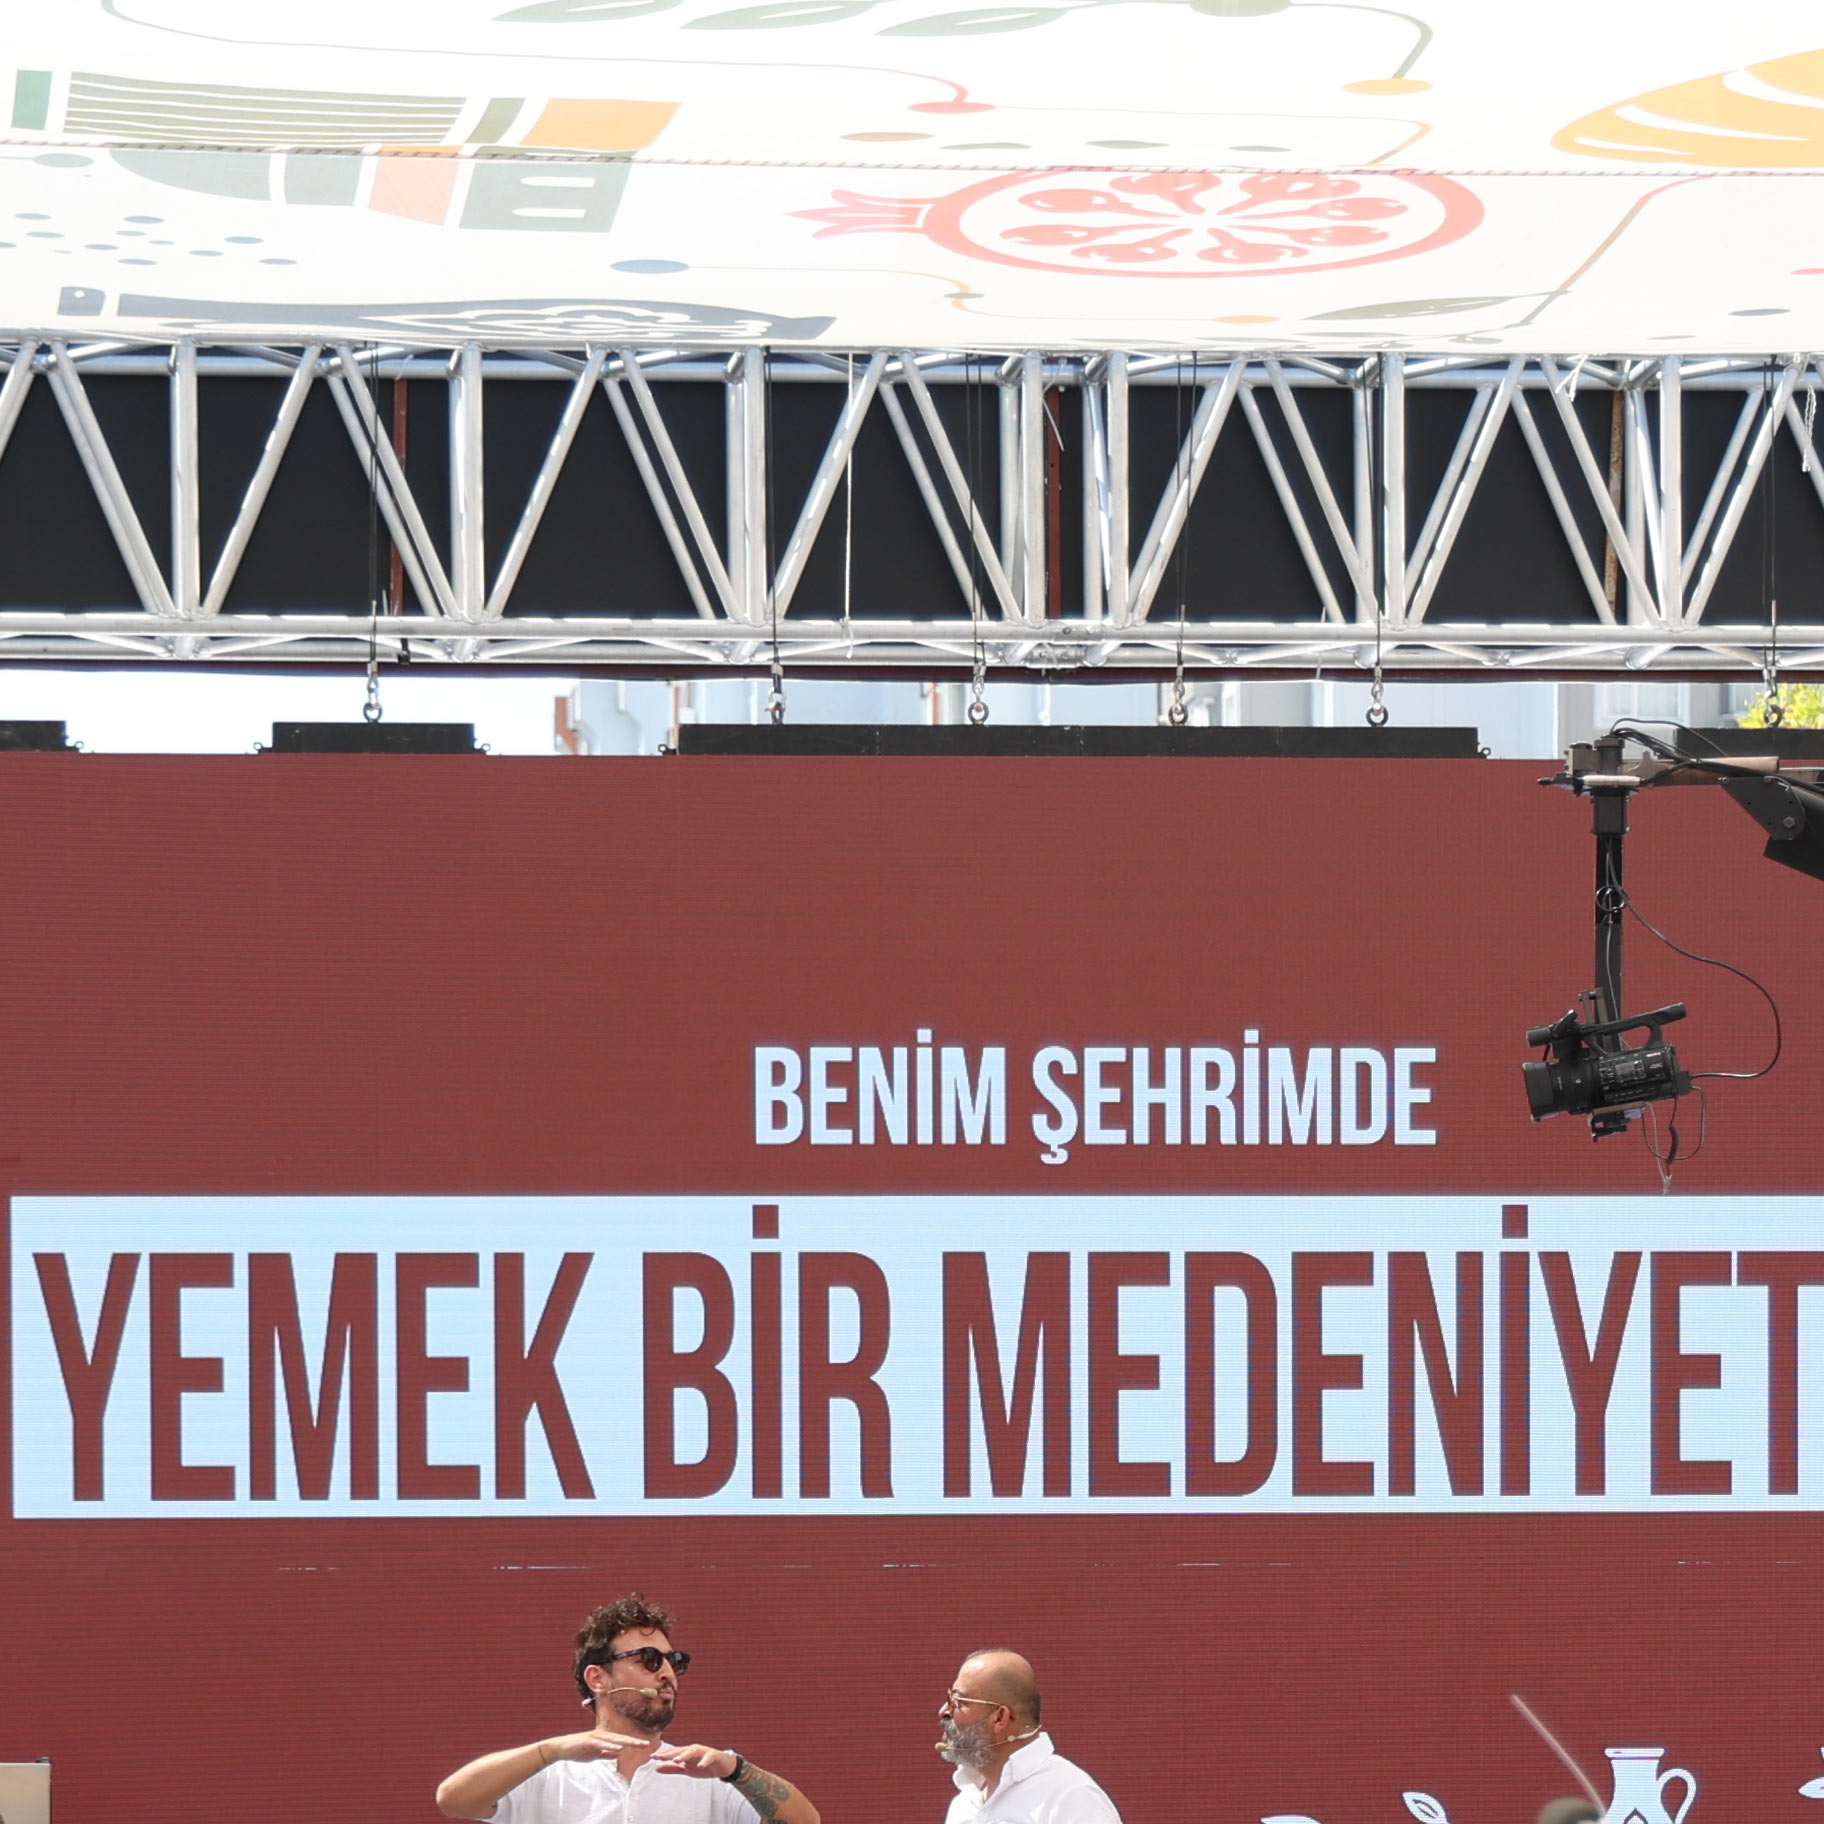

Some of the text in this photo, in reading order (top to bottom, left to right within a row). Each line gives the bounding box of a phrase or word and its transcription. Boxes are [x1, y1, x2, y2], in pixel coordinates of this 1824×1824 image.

[754, 1028, 1437, 1165] BENİM ŞEHRİMDE
[33, 1250, 596, 1502] YEMEK
[642, 1204, 894, 1500] BİR
